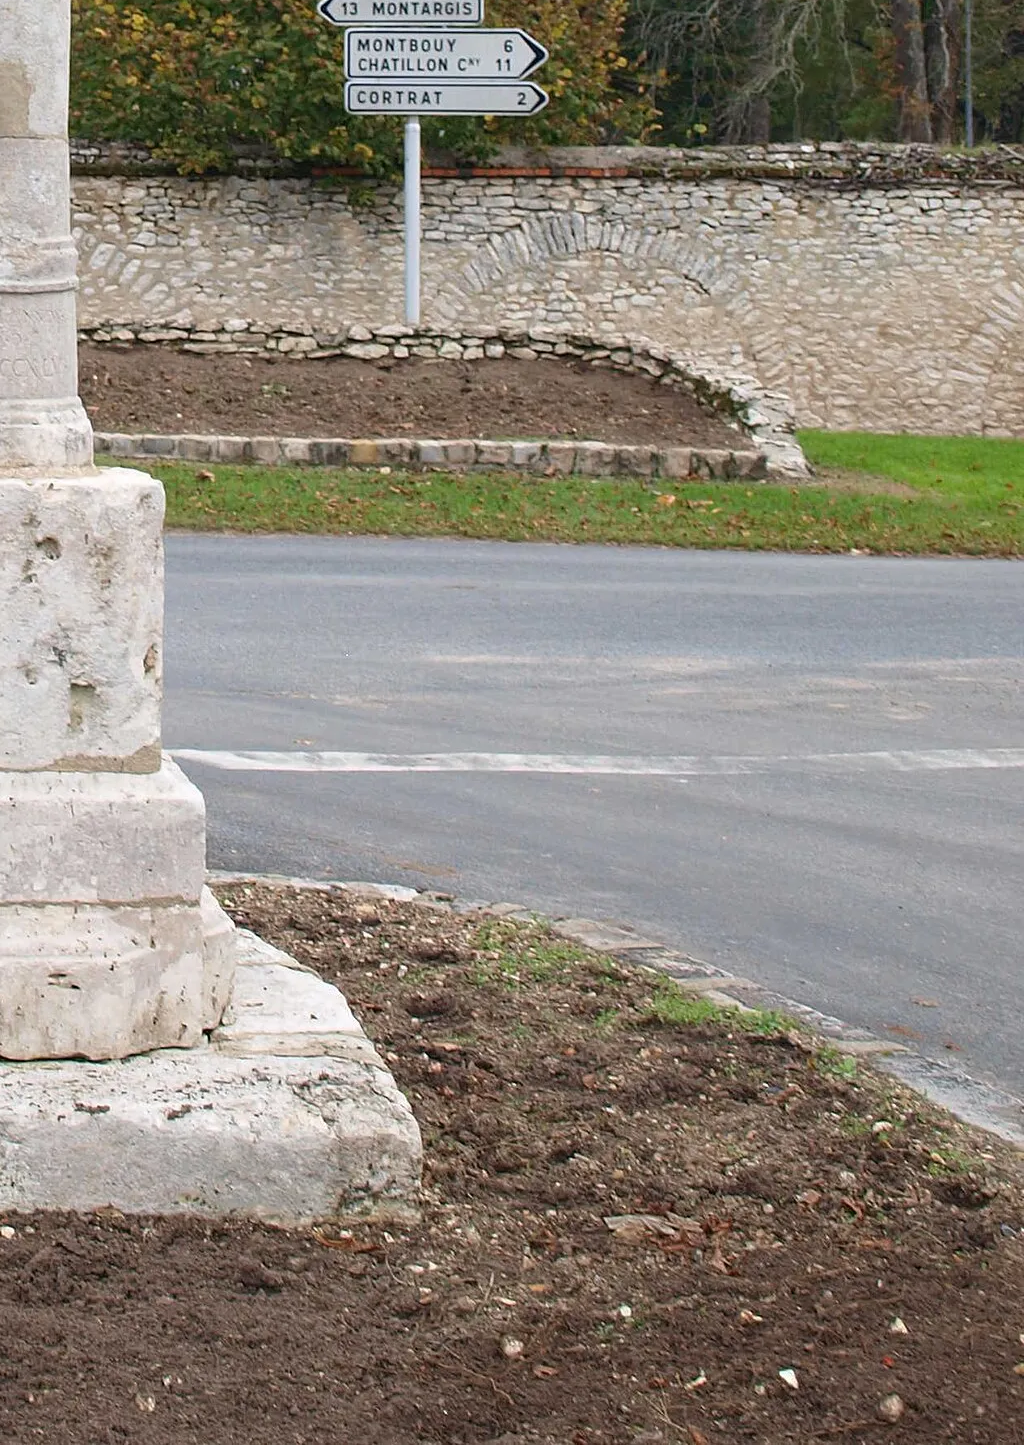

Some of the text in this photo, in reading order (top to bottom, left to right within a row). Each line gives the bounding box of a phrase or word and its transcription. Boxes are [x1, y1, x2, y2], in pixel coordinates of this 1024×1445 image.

[341, 2, 473, 16] 13 MONTARGIS
[357, 38, 514, 53] MONTBOUY 6
[358, 58, 448, 72] CHATILLON
[495, 58, 511, 72] 11
[357, 91, 527, 106] CORTRAT 2
